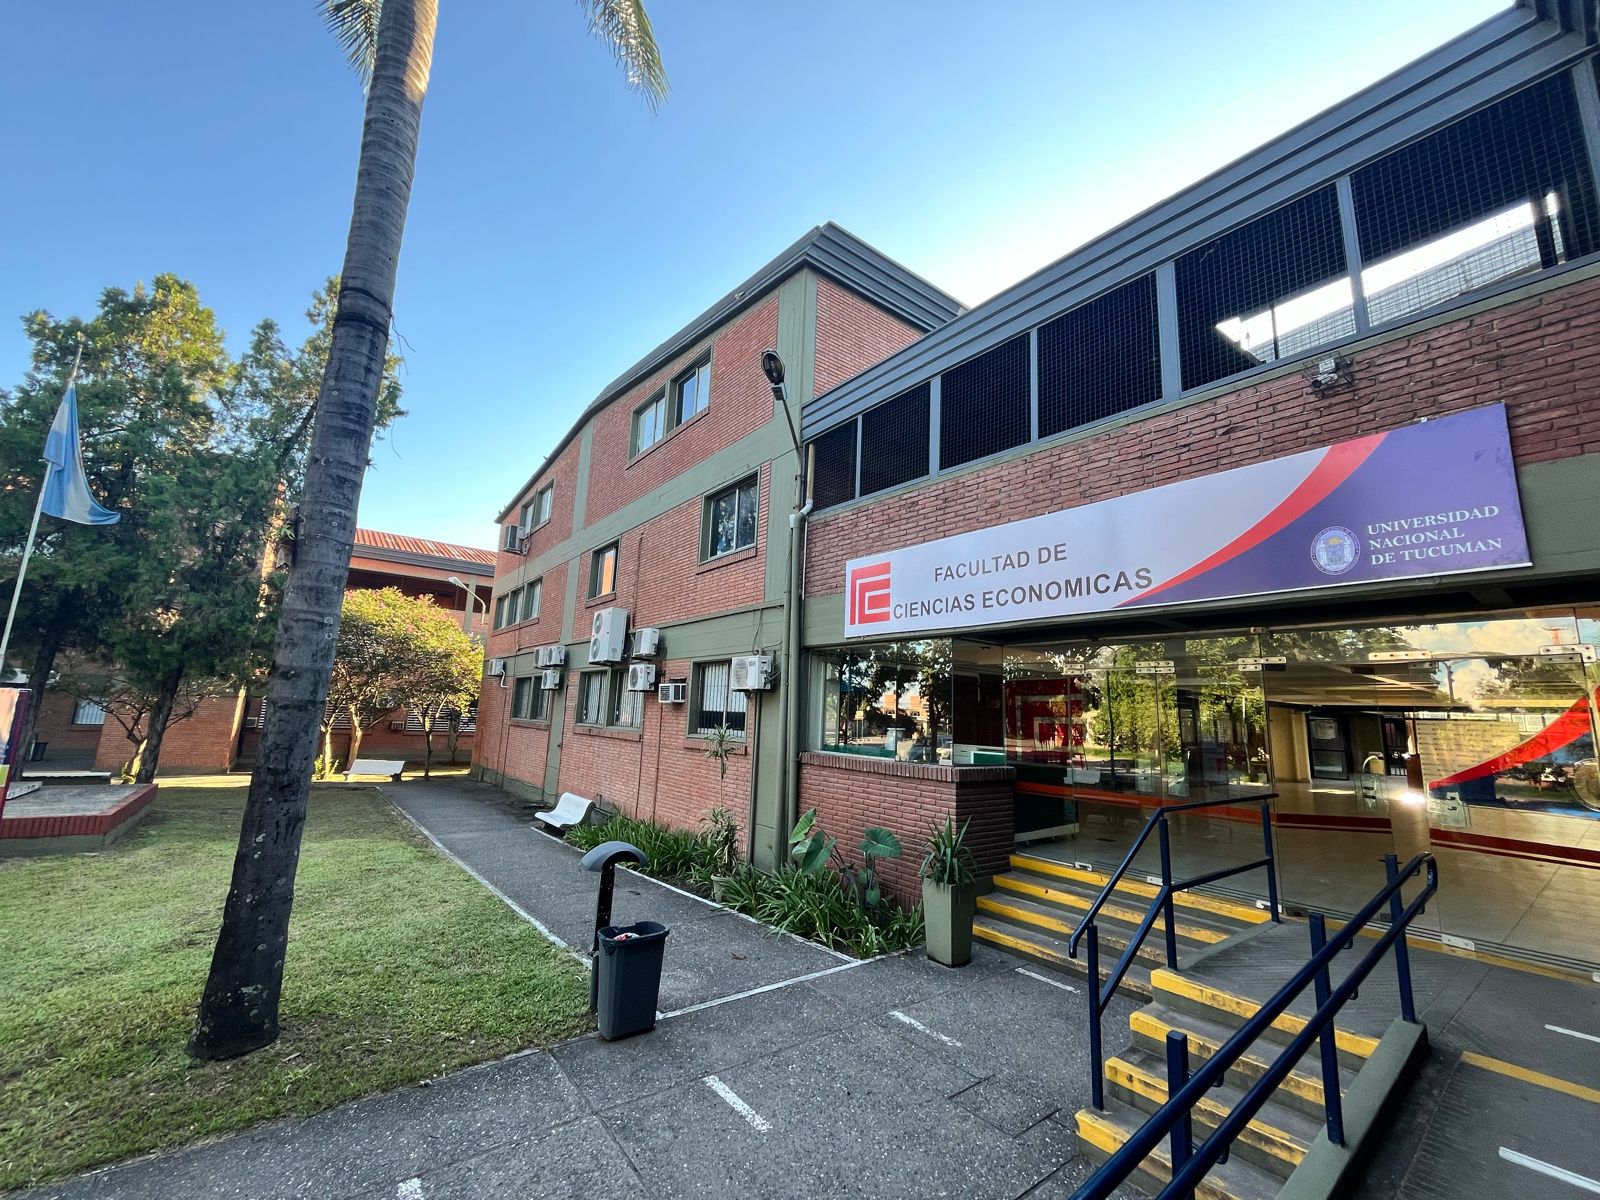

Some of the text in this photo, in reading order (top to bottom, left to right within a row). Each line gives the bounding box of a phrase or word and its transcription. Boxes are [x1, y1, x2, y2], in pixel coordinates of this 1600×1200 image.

[1367, 505, 1499, 535] UNIVERSIDAD
[1369, 527, 1465, 550] NACIONAL
[1371, 538, 1502, 566] DE TUCUMAN
[934, 543, 1067, 582] FACULTAD DE
[893, 593, 975, 619] CIENCIAS
[982, 567, 1153, 608] ECONOMICAS
